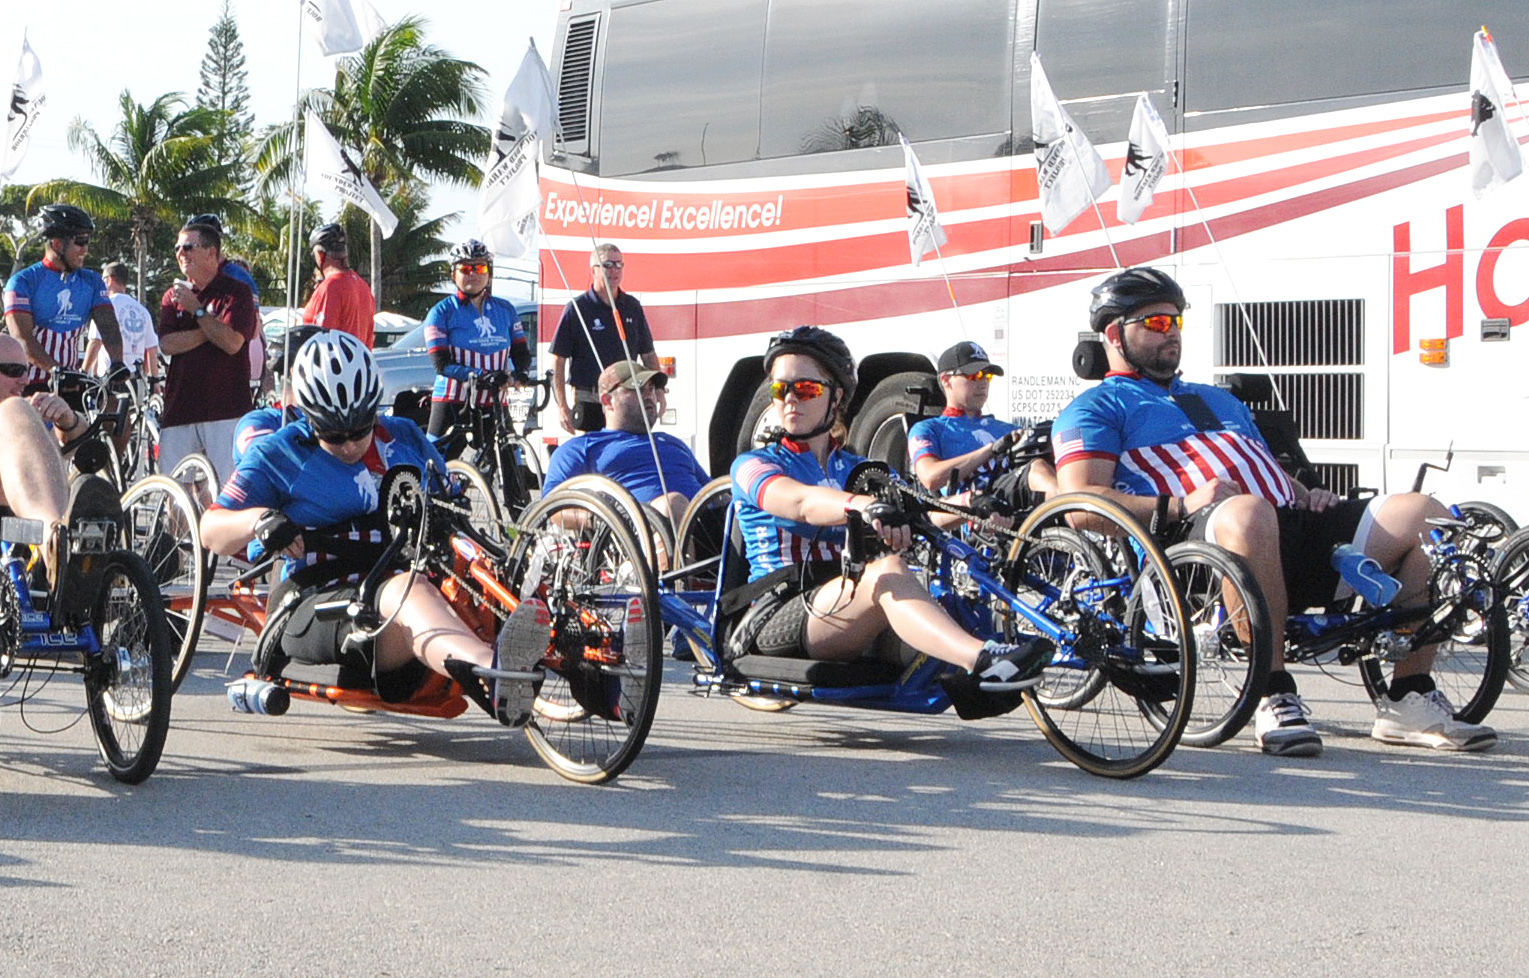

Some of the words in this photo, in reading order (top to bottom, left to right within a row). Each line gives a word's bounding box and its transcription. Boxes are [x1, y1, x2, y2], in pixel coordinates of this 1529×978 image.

[545, 192, 657, 228] Experience!
[660, 195, 784, 230] Excellence!
[1012, 376, 1066, 386] RANDLEMAN
[1069, 376, 1081, 386] NC
[1012, 390, 1023, 400] US
[1026, 390, 1043, 400] DOT
[1012, 403, 1037, 412] SCPSC
